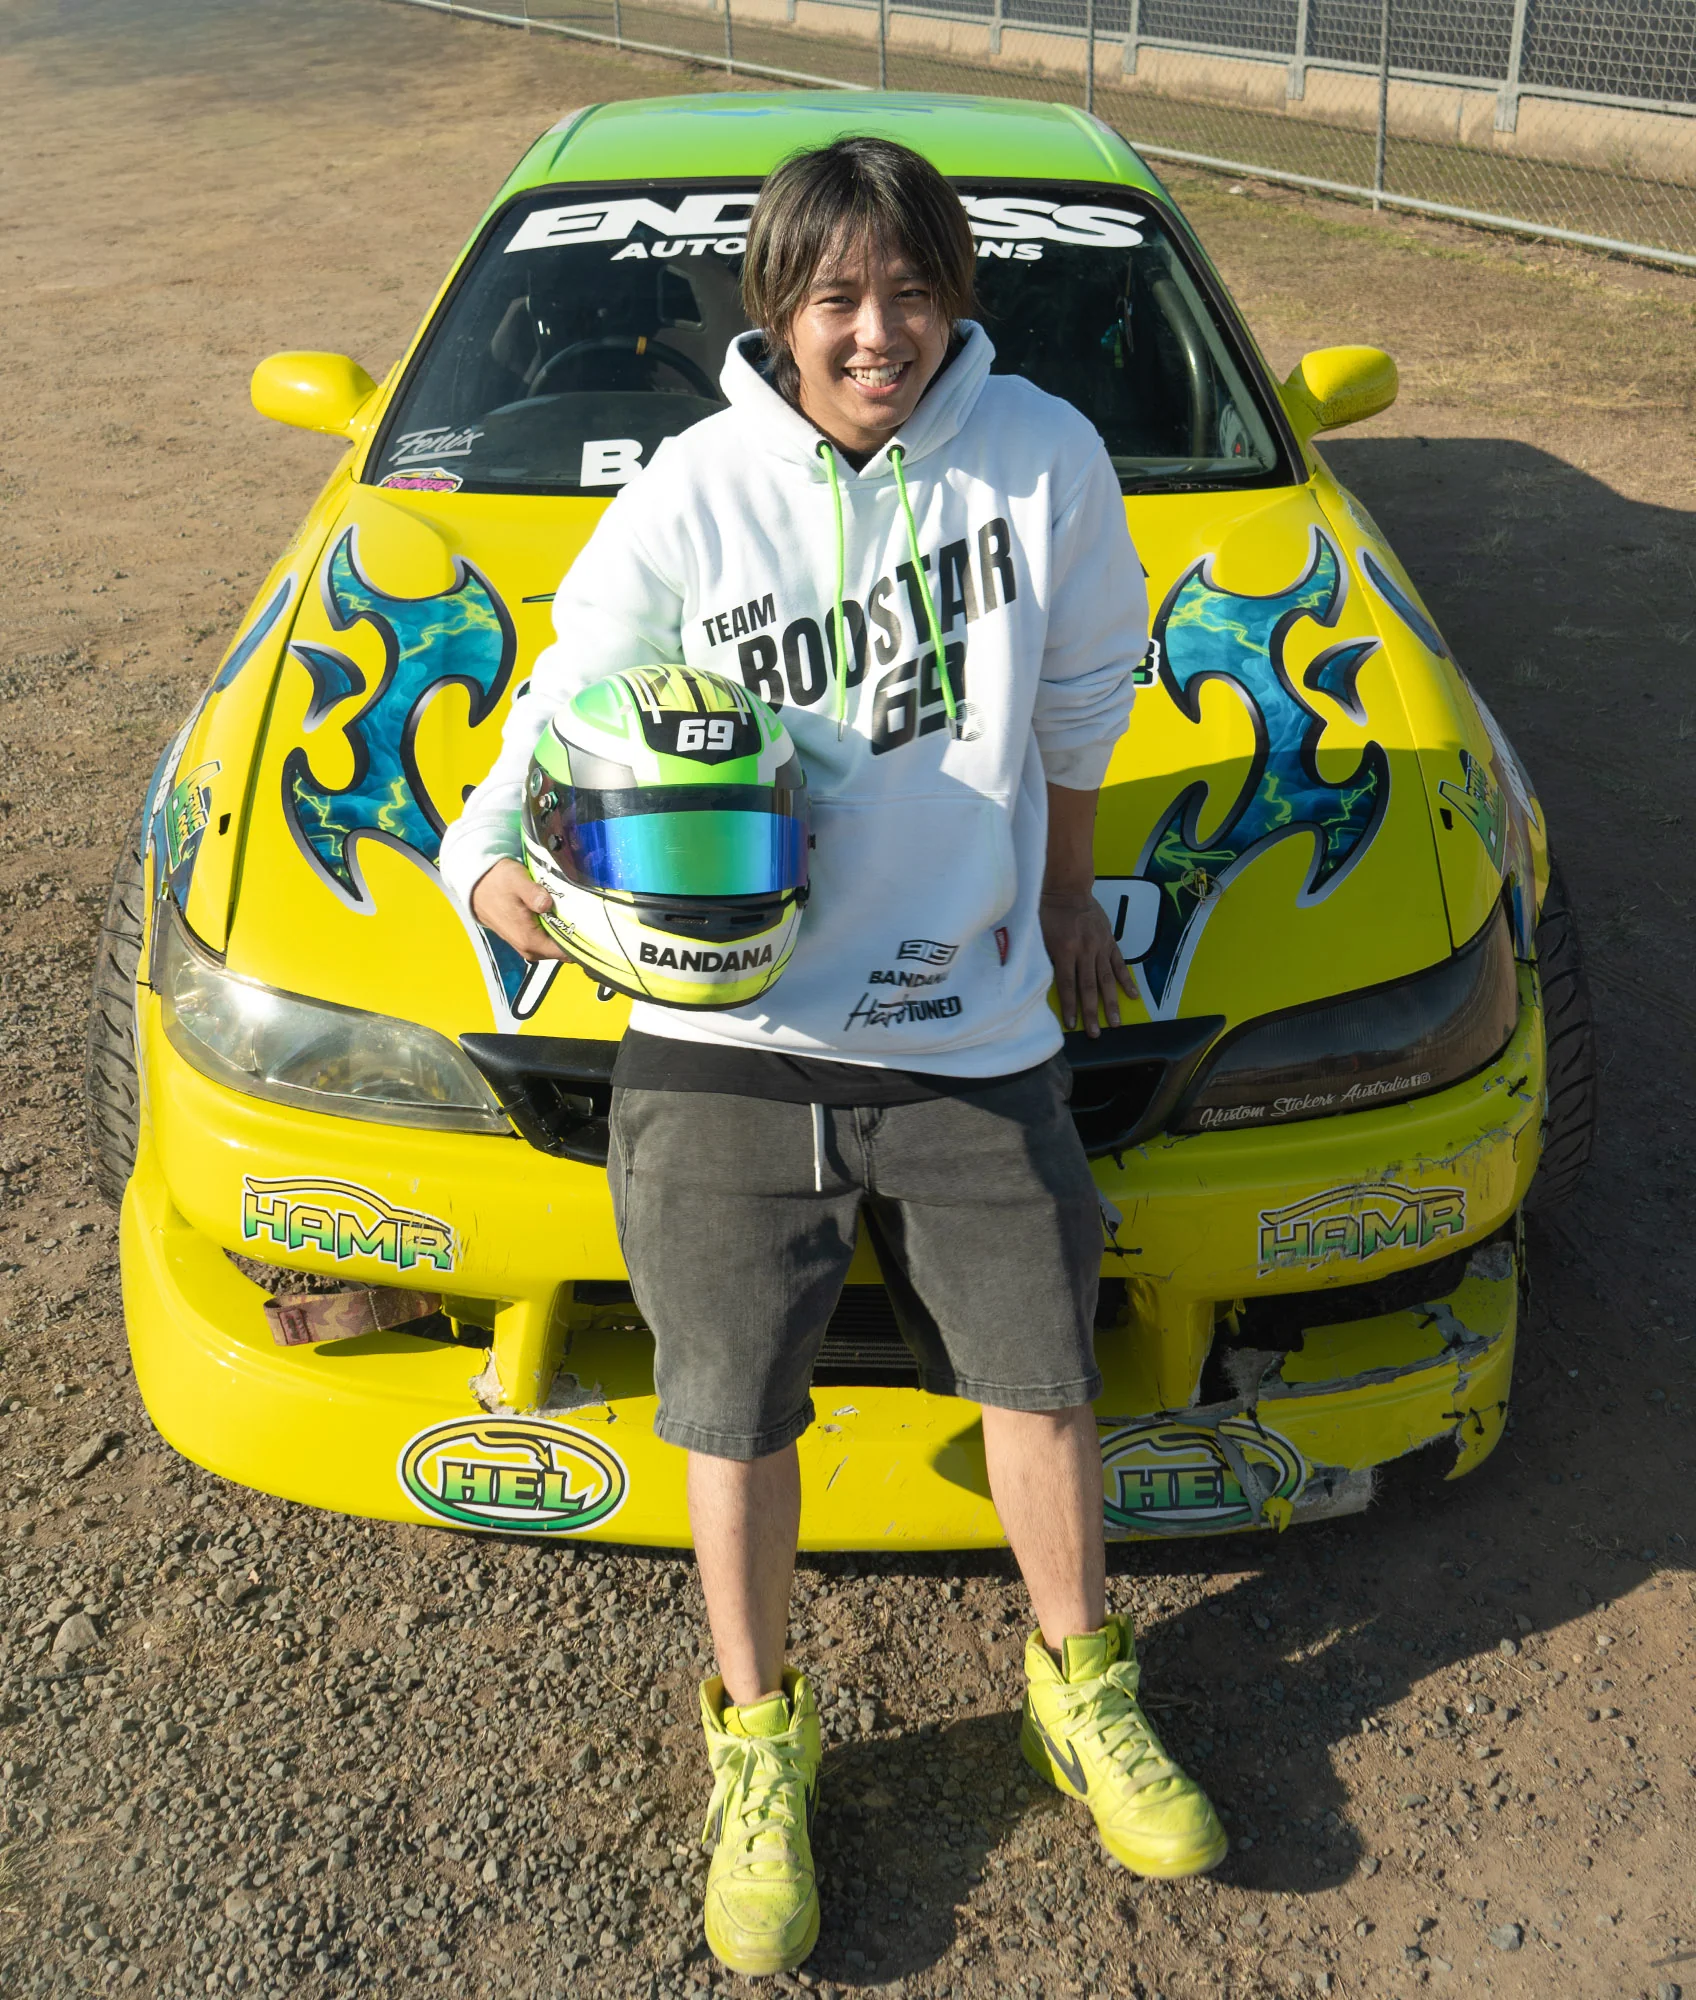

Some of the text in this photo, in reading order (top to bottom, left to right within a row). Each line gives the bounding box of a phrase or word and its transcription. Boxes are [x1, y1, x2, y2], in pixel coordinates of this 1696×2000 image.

[702, 593, 776, 646] TEAM
[738, 517, 1017, 714] BOOSTAR
[871, 641, 967, 755] 69
[677, 719, 735, 752] 69
[639, 941, 773, 973] BANDANA
[868, 969, 950, 987] BANDAN
[1270, 1093, 1337, 1117] Stickers
[1341, 1076, 1411, 1103] Australia
[244, 1191, 453, 1270] HAMR
[1257, 1195, 1466, 1277] HAMR
[441, 1456, 590, 1511] HEL
